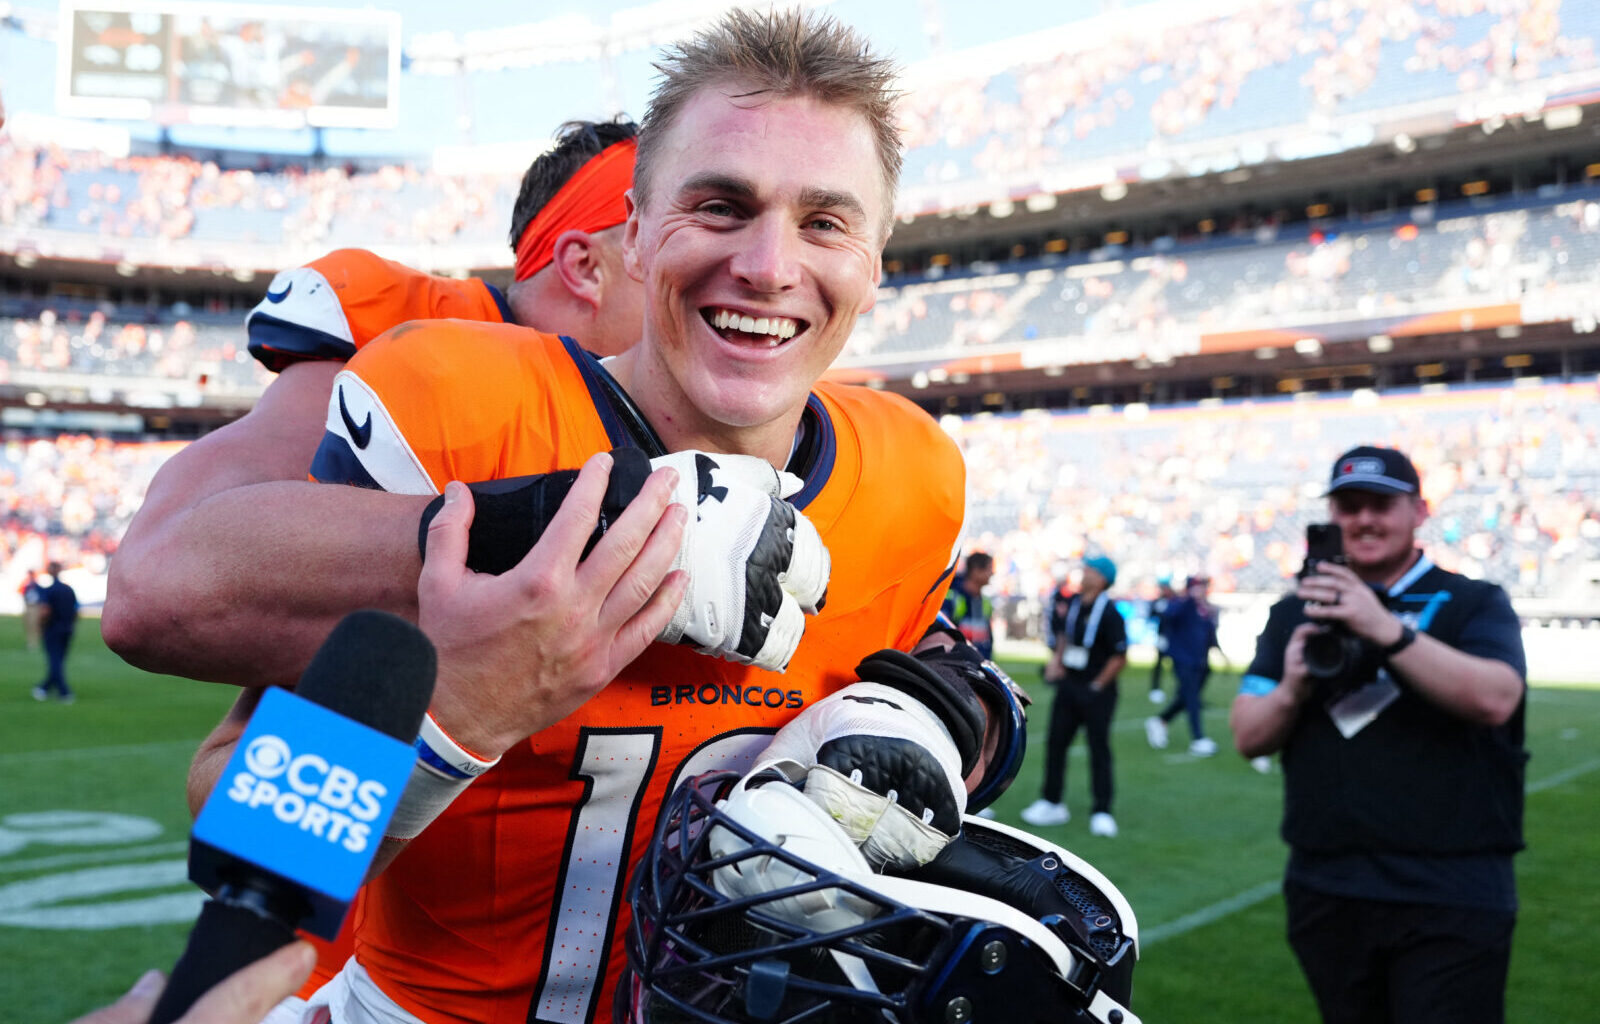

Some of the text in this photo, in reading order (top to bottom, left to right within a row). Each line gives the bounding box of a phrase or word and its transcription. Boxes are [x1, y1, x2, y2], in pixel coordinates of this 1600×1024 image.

[651, 683, 804, 708] BRONCOS
[227, 772, 371, 853] SPORTS
[287, 753, 388, 822] CBS
